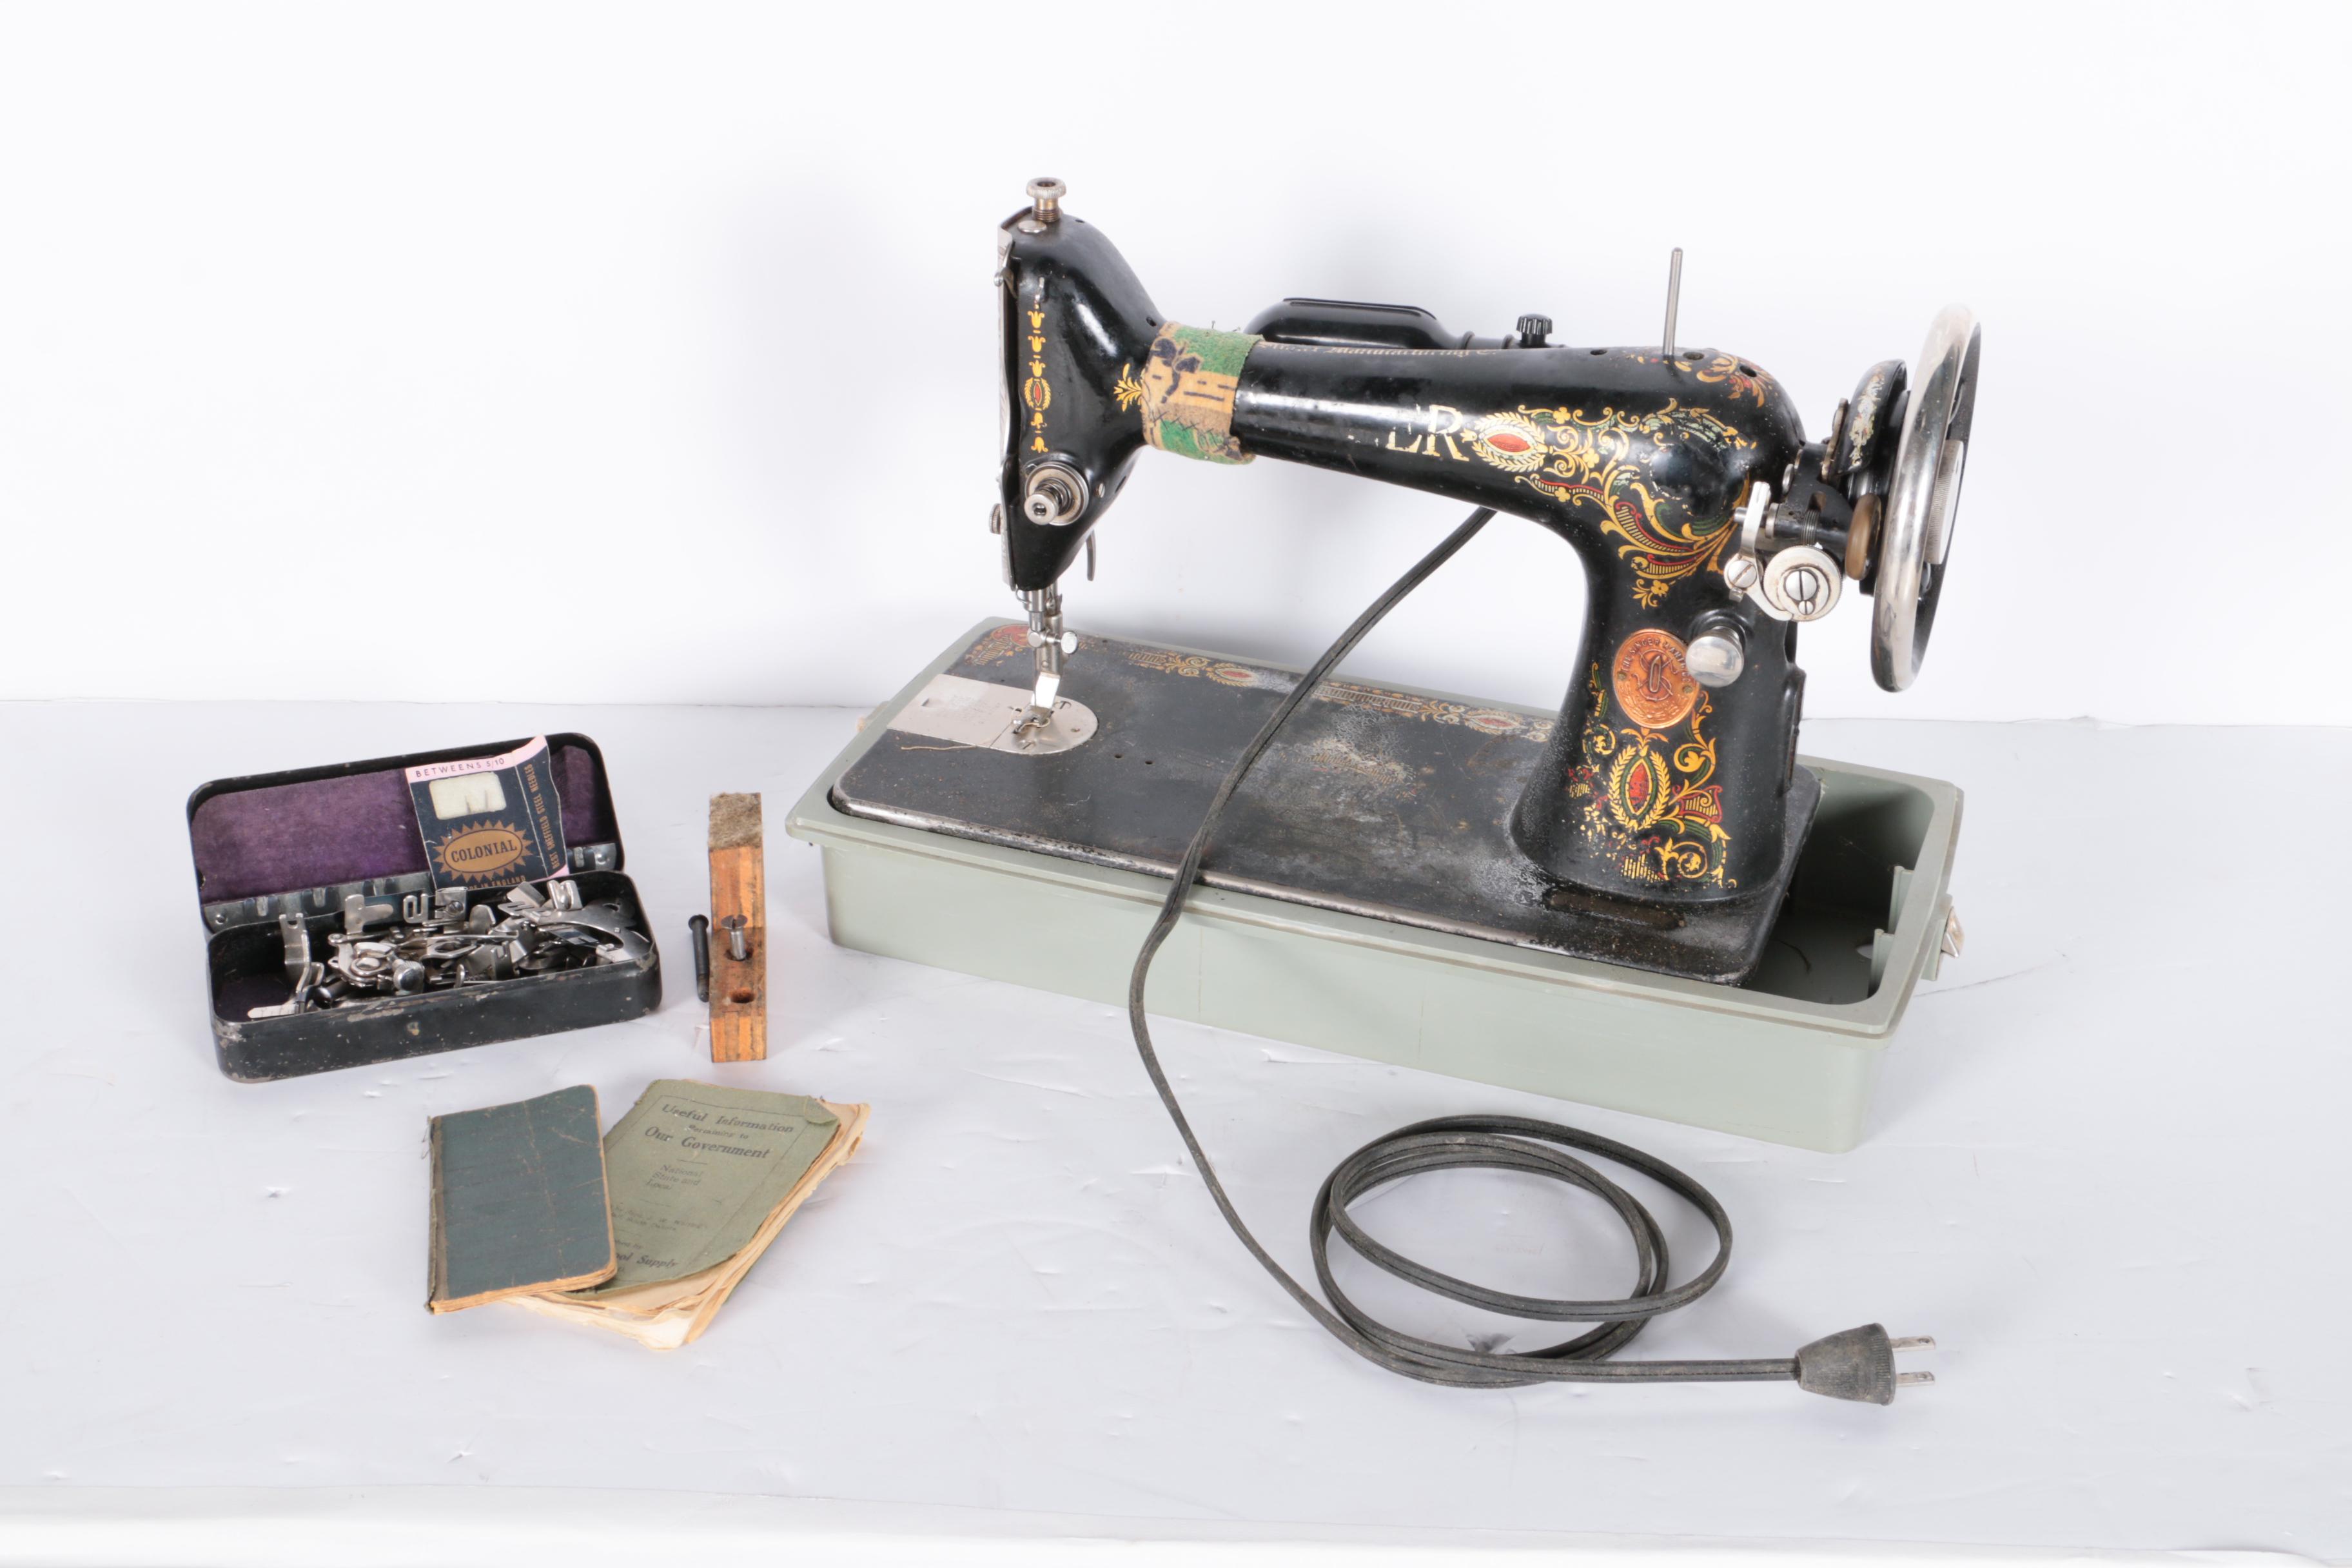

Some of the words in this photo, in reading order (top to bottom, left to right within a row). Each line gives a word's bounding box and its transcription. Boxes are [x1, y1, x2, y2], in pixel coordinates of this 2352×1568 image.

[415, 761, 482, 778] BETWEENS
[486, 758, 504, 769] 5/10
[524, 763, 539, 794] NEEDLES
[533, 793, 545, 815] STEEL
[539, 815, 556, 850] SHEFFIELD
[451, 839, 518, 863] COLONIAL
[549, 851, 560, 869] BEST
[492, 875, 526, 887] ENGLAND
[662, 1103, 708, 1122] Useful
[715, 1115, 794, 1133] Information
[644, 1126, 674, 1142] Our
[681, 1135, 771, 1159] Government
[636, 1254, 679, 1268] Supply
